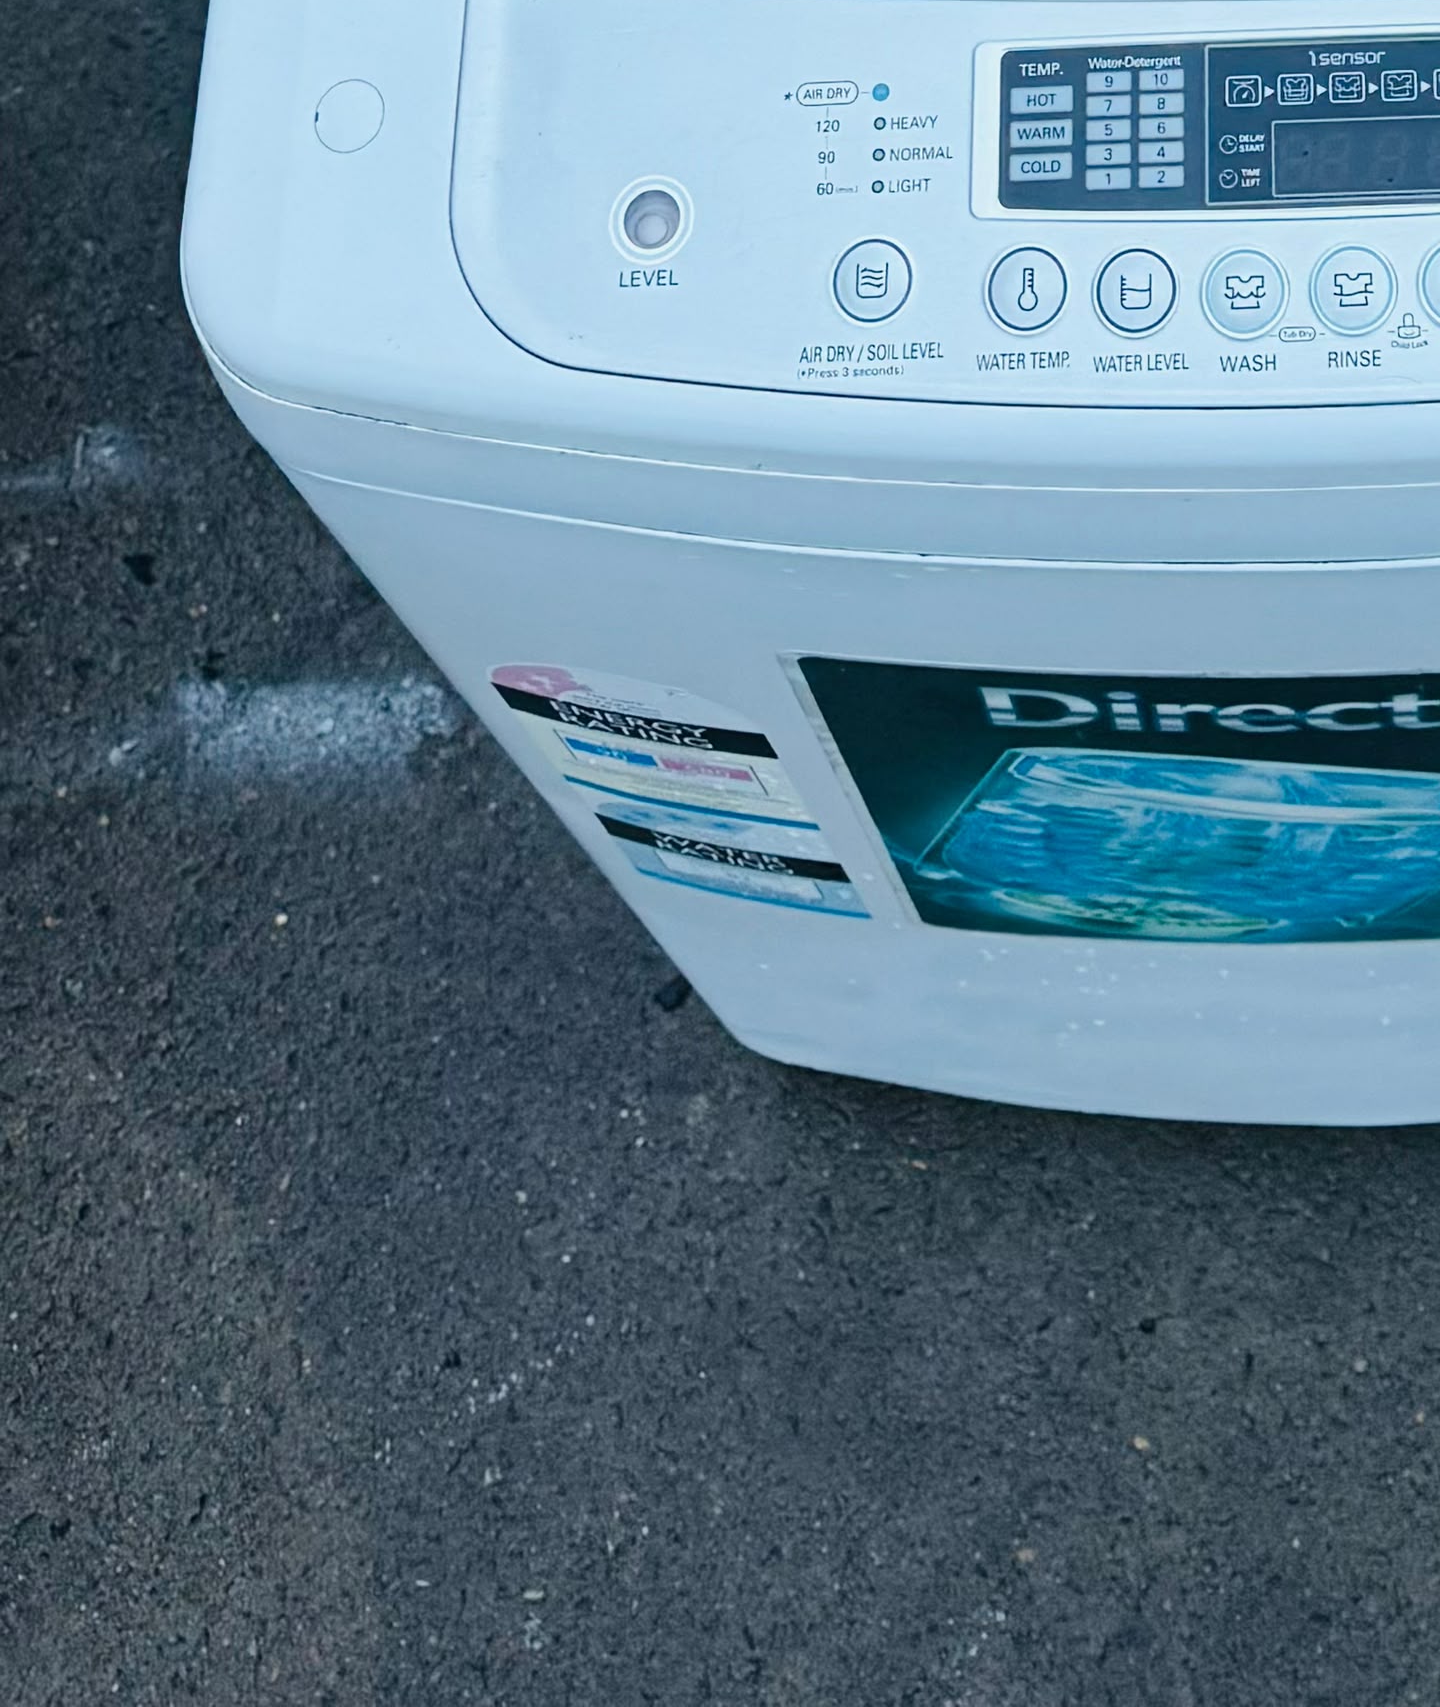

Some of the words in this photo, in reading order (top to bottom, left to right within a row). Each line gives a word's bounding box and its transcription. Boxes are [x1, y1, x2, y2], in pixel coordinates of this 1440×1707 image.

[1019, 62, 1064, 77] TEMP.
[1104, 75, 1113, 88] 9
[1154, 73, 1168, 86] 10
[803, 88, 823, 100] AIR
[826, 87, 851, 99] DRY
[1026, 93, 1056, 107] HOT
[1104, 99, 1113, 112] 7
[1157, 97, 1166, 110] 8
[816, 120, 840, 133] 120
[890, 115, 938, 130] HEAVY
[1104, 123, 1113, 136] 5
[1157, 121, 1166, 134] 6
[1017, 126, 1065, 140] WARM
[818, 150, 836, 164] 90
[889, 146, 953, 162] NORMAL
[1104, 148, 1113, 161] 3
[1157, 146, 1166, 158] 4
[1021, 159, 1061, 174] COLD
[1105, 173, 1111, 185] 1
[1157, 170, 1166, 183] 2
[816, 182, 834, 196] 60
[888, 178, 931, 193] LIGHT
[619, 269, 679, 287] LEVEL
[799, 346, 823, 363] AIR
[826, 345, 854, 363] DRY
[867, 344, 899, 361] SOIL
[902, 342, 944, 360] LEVEL
[1328, 349, 1382, 368] RINSE
[976, 353, 1026, 371] WATER
[1030, 351, 1070, 369] TEMP.
[1093, 354, 1143, 373] WATER
[1147, 353, 1189, 372] LEVEL
[1219, 354, 1277, 372] WASH
[842, 366, 849, 378] 3
[550, 699, 707, 737] ENERGY
[558, 712, 714, 749] RATING
